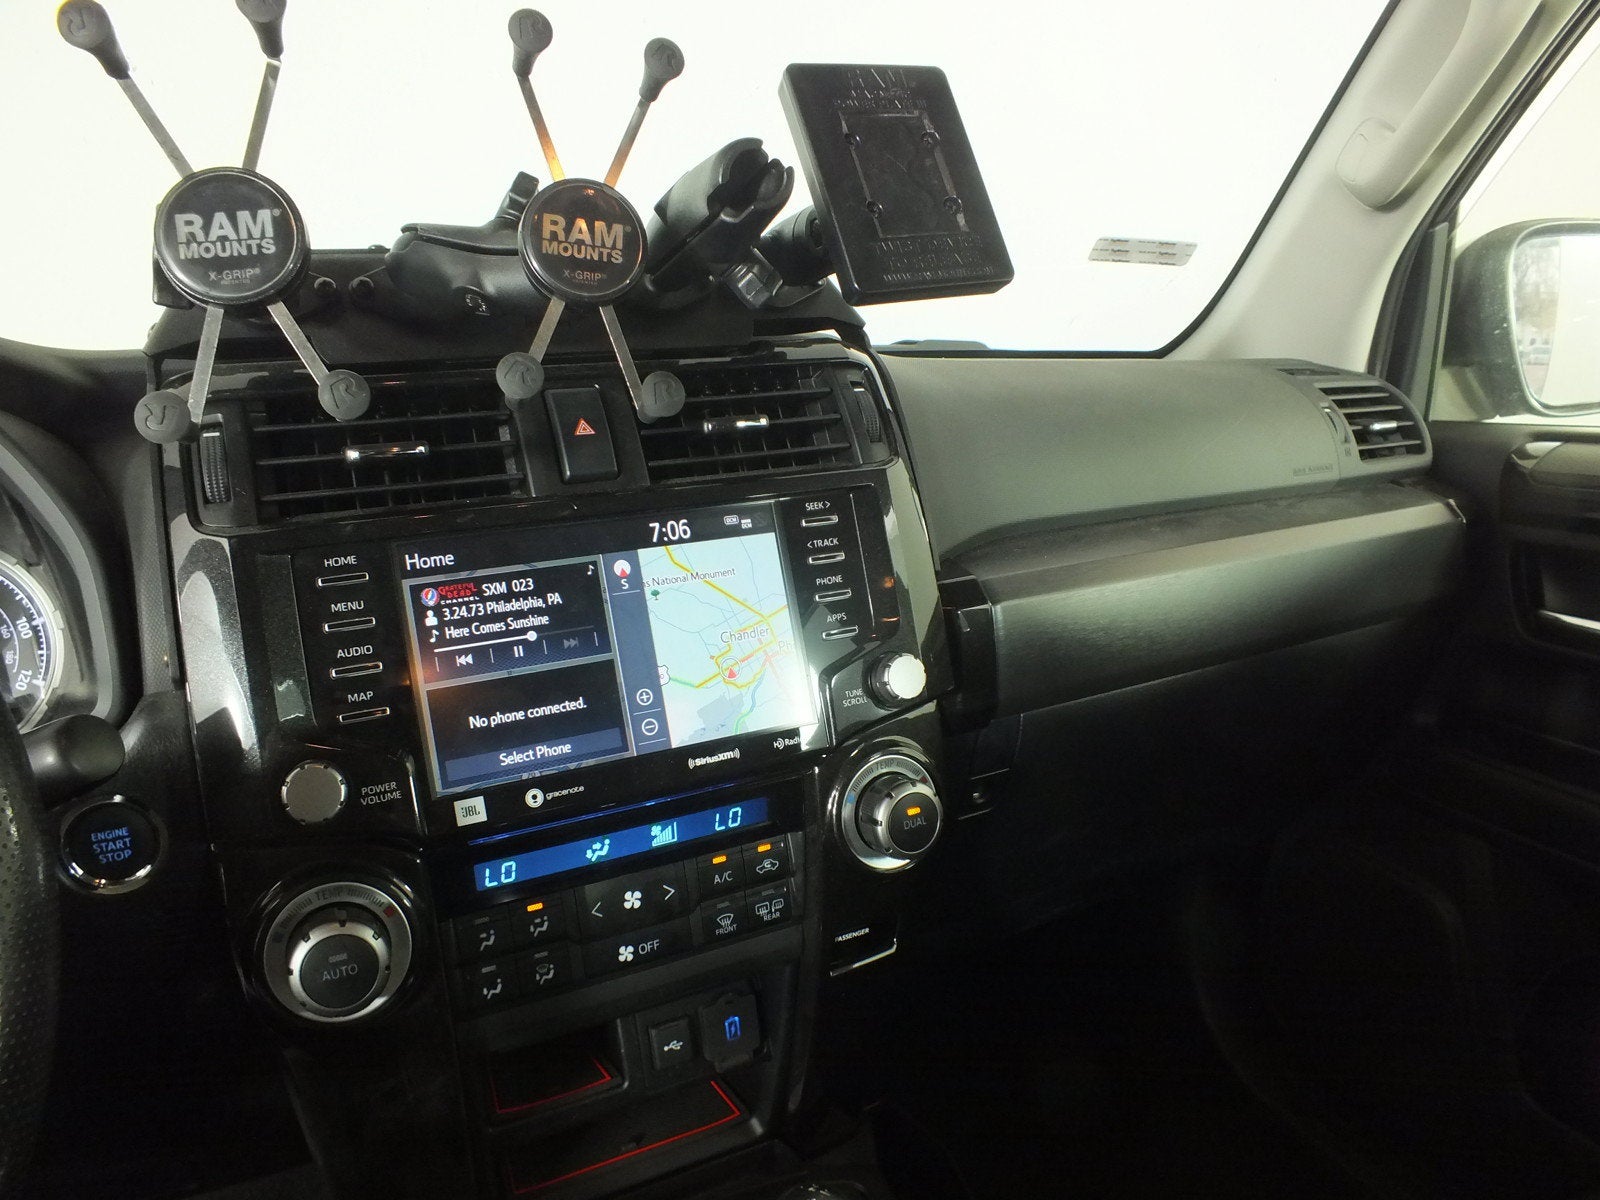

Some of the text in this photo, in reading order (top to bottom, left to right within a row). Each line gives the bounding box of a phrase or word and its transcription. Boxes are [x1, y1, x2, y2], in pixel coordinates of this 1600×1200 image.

[174, 209, 275, 243] RAM
[541, 212, 624, 250] RAM
[178, 238, 277, 260] MOUNTS
[542, 239, 623, 265] MOUNTS
[805, 500, 825, 511] SEEK
[649, 518, 691, 543] 7:06
[813, 537, 840, 548] TRACK
[324, 556, 357, 567] HOME
[404, 552, 455, 571] Home
[621, 579, 629, 590] S
[652, 573, 689, 587] National
[690, 568, 736, 581] Monument
[815, 575, 844, 586] PHONE
[447, 589, 472, 599] DEAD
[481, 578, 534, 597] SXM 023
[331, 601, 365, 613] MENU
[440, 596, 480, 605] CHANNEL
[442, 592, 563, 621] 3.24.73 Philadelphia, PA
[826, 612, 848, 624] APPS
[16, 616, 33, 640] 100
[445, 614, 550, 640] Here Comes Sunshine
[720, 626, 770, 644] Chandler
[337, 644, 374, 659] AUDIO
[15, 669, 33, 692] 120
[347, 690, 375, 704] MAP
[845, 687, 864, 698] TUNE
[468, 696, 588, 730] No phone connected.
[499, 743, 572, 767] Select Phone
[361, 781, 398, 796] POWER
[545, 785, 585, 801] gracenote
[360, 791, 403, 806] VOLUME
[462, 804, 481, 818] JBL
[903, 817, 928, 830] DUAL
[91, 826, 129, 841] ENGINE
[92, 837, 132, 852] START
[99, 850, 132, 863] STOP
[713, 870, 734, 885] A/C
[763, 910, 781, 922] REAR
[715, 923, 738, 936] FRONT
[834, 927, 870, 943] PASSENGER
[638, 938, 660, 955] OFF
[322, 963, 358, 982] AUTO
